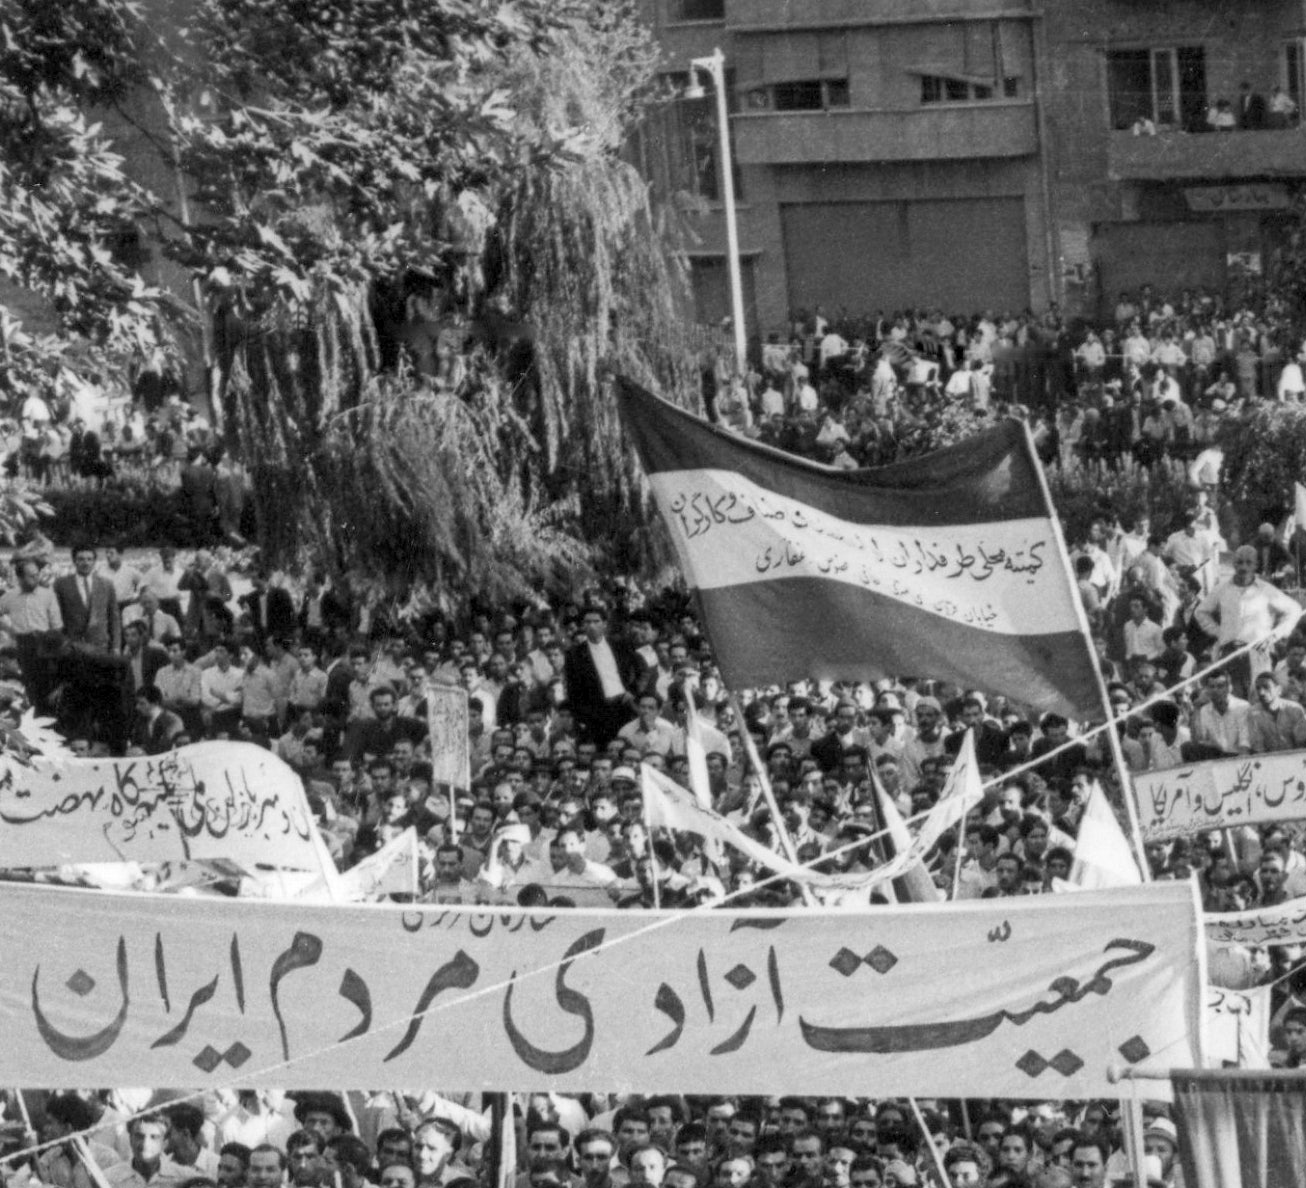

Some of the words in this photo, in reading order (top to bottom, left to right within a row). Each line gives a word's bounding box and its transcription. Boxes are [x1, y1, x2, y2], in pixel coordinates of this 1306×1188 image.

[32, 931, 253, 1074] ایران
[269, 930, 481, 1063] مردم
[501, 916, 788, 1075] آزادی
